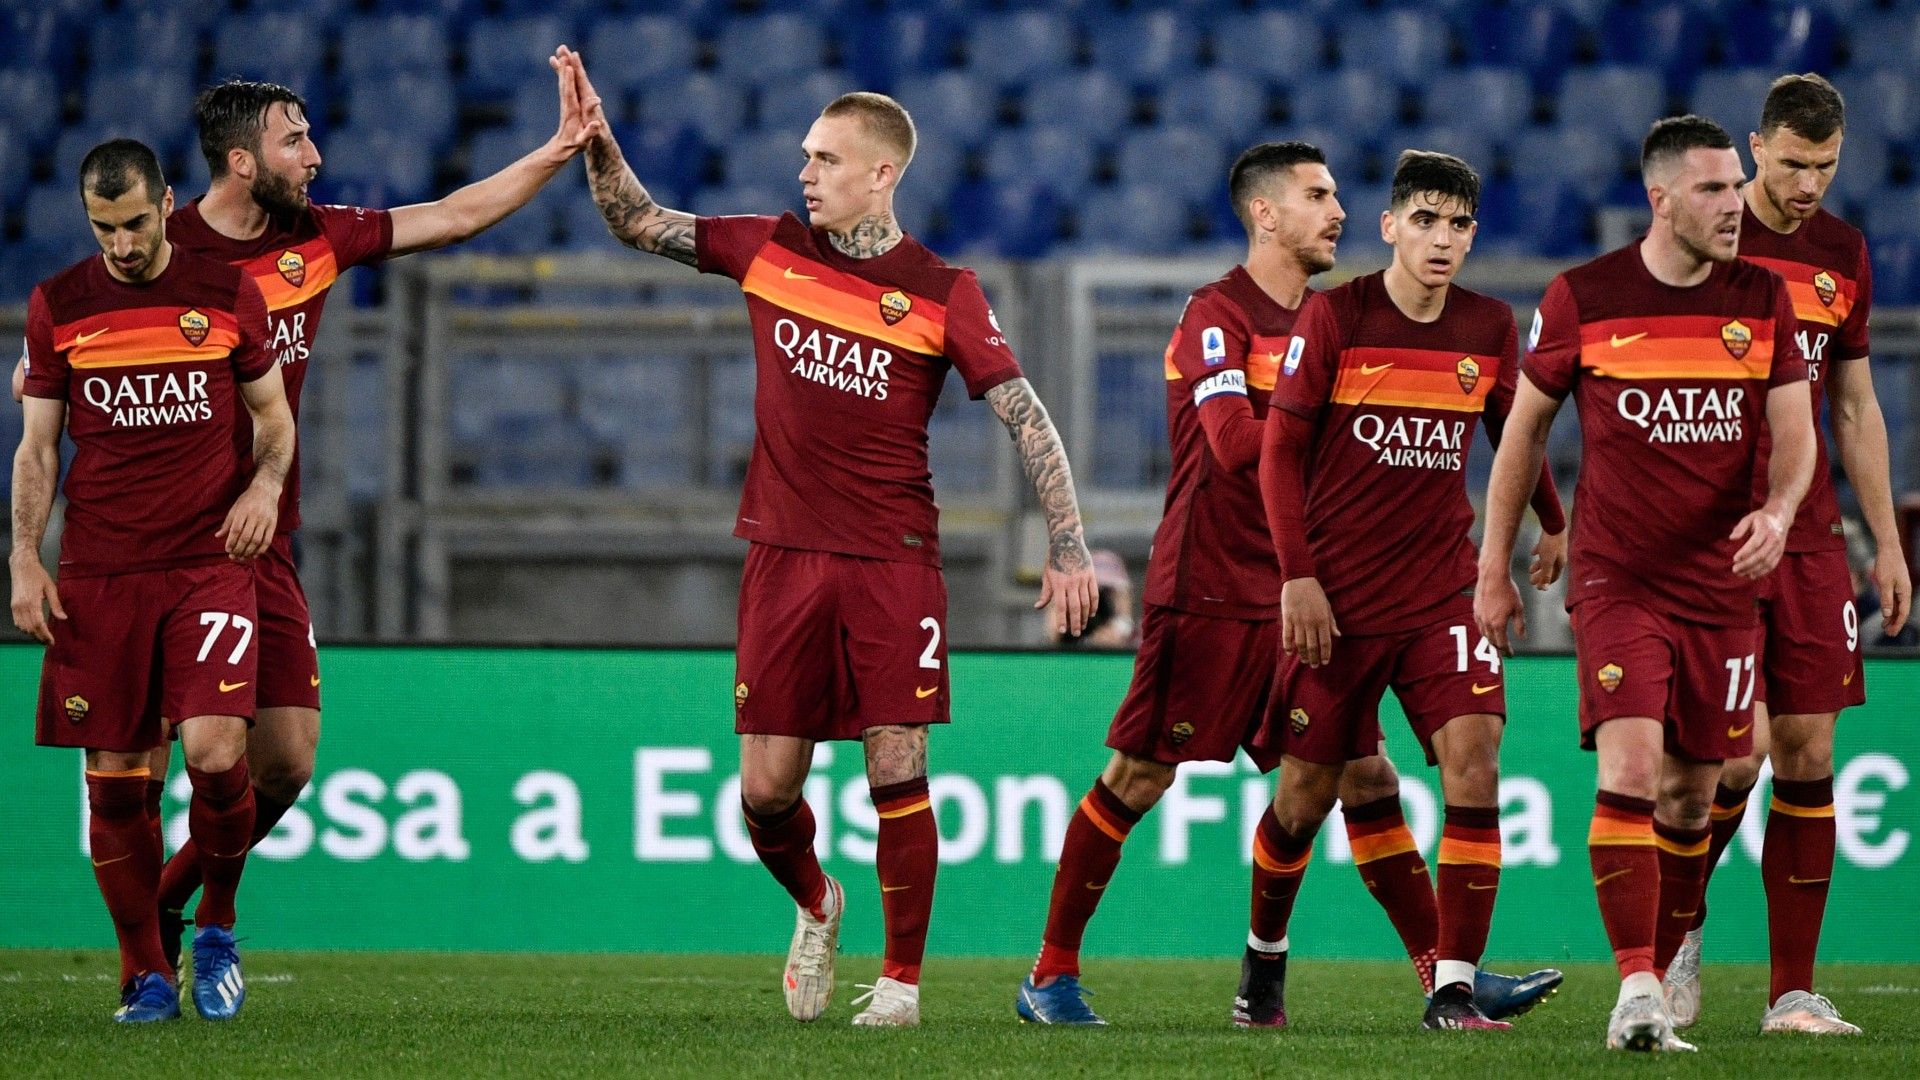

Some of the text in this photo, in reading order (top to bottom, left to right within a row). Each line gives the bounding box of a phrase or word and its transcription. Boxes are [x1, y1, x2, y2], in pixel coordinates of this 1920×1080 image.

[774, 318, 893, 381] QATAR
[83, 370, 208, 414] QATAR
[790, 356, 889, 401] AIRWAYS
[112, 400, 213, 427] AIRWAYS
[1617, 387, 1744, 428] QATAR
[1648, 419, 1743, 443] AIRWAYS
[1353, 414, 1466, 451] QATAR
[1377, 447, 1461, 471] AIRWAYS
[196, 611, 254, 666] 77
[919, 616, 941, 670] 2
[1842, 600, 1859, 652] 9
[1449, 625, 1501, 675] 14
[1725, 653, 1756, 712] 17
[511, 770, 590, 862] a
